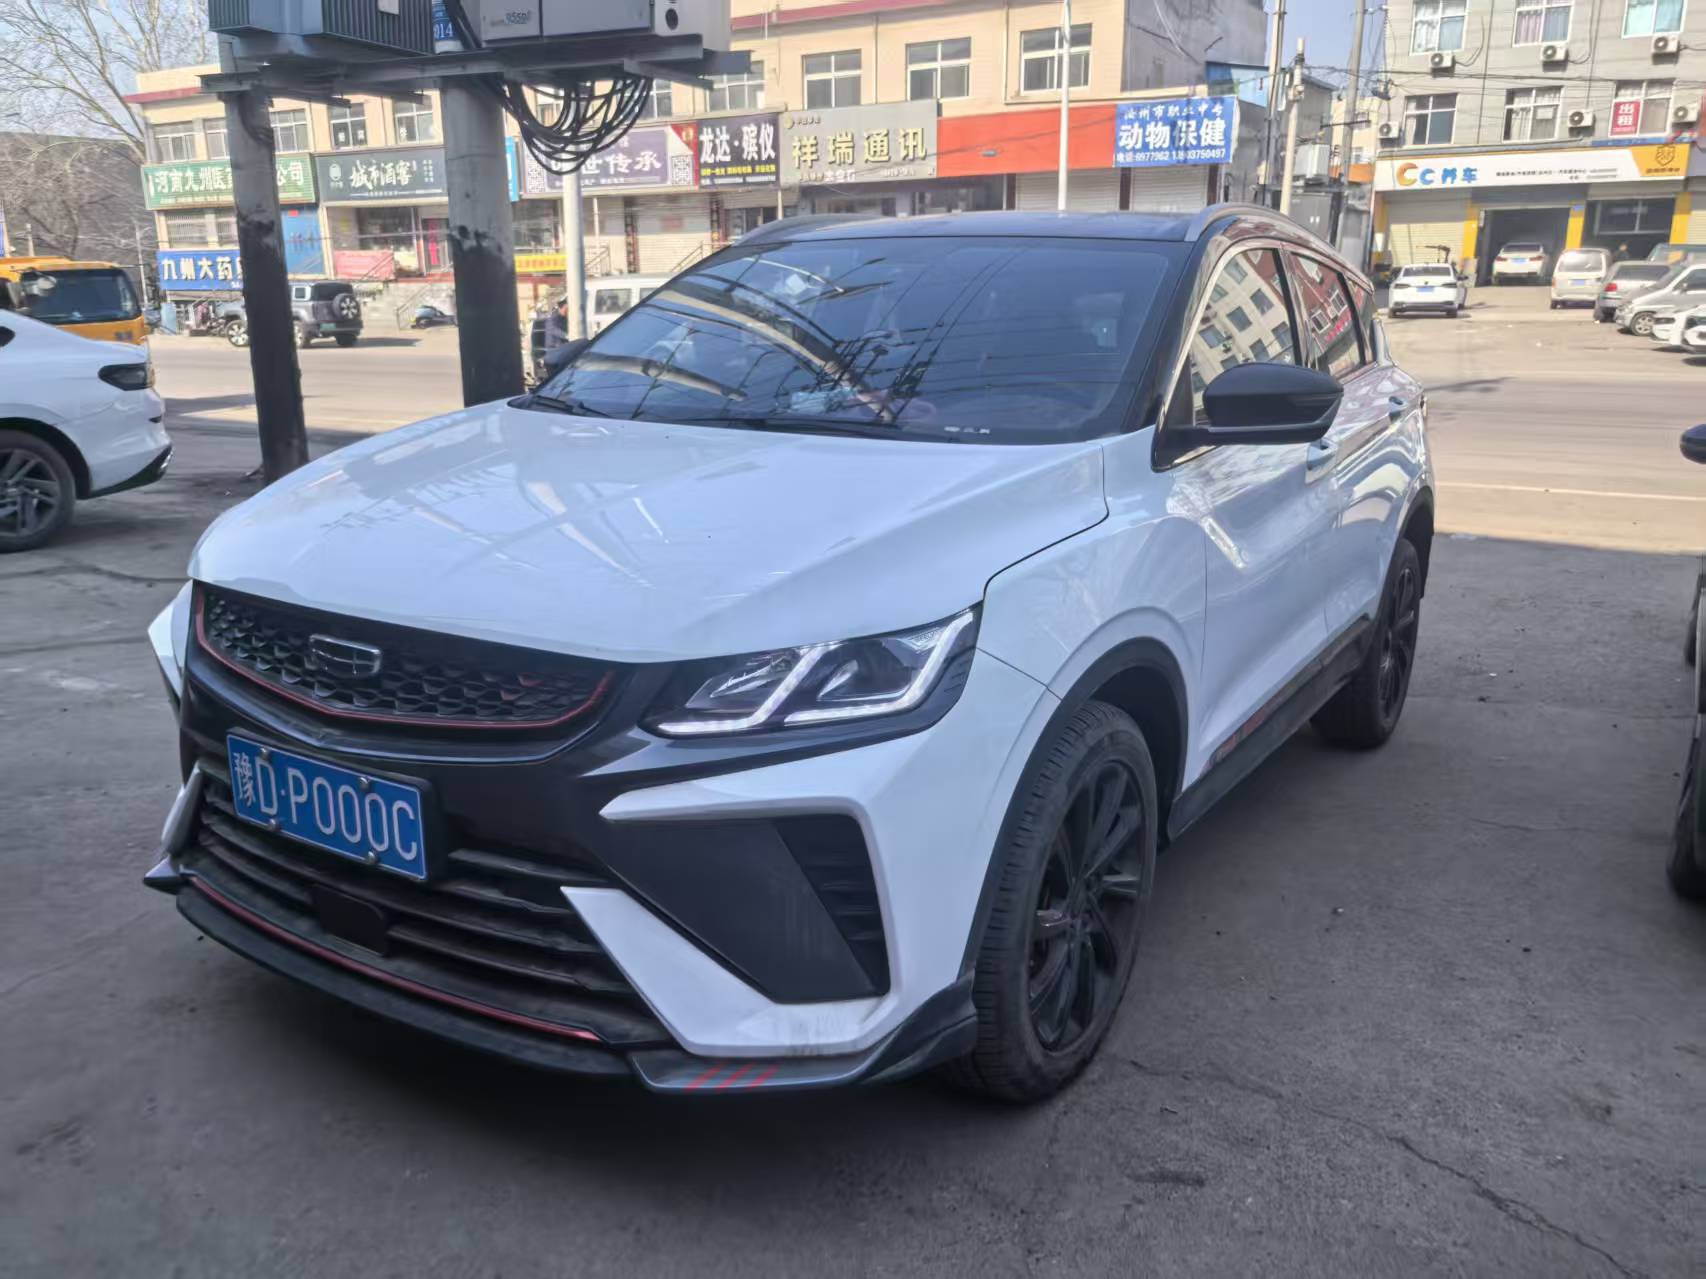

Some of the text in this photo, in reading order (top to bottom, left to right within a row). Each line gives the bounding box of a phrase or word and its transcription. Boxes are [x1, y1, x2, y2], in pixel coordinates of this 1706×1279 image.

[1617, 103, 1635, 126] 出租
[791, 127, 928, 170] 祥瑞通讯
[1118, 117, 1226, 150] 动物保健
